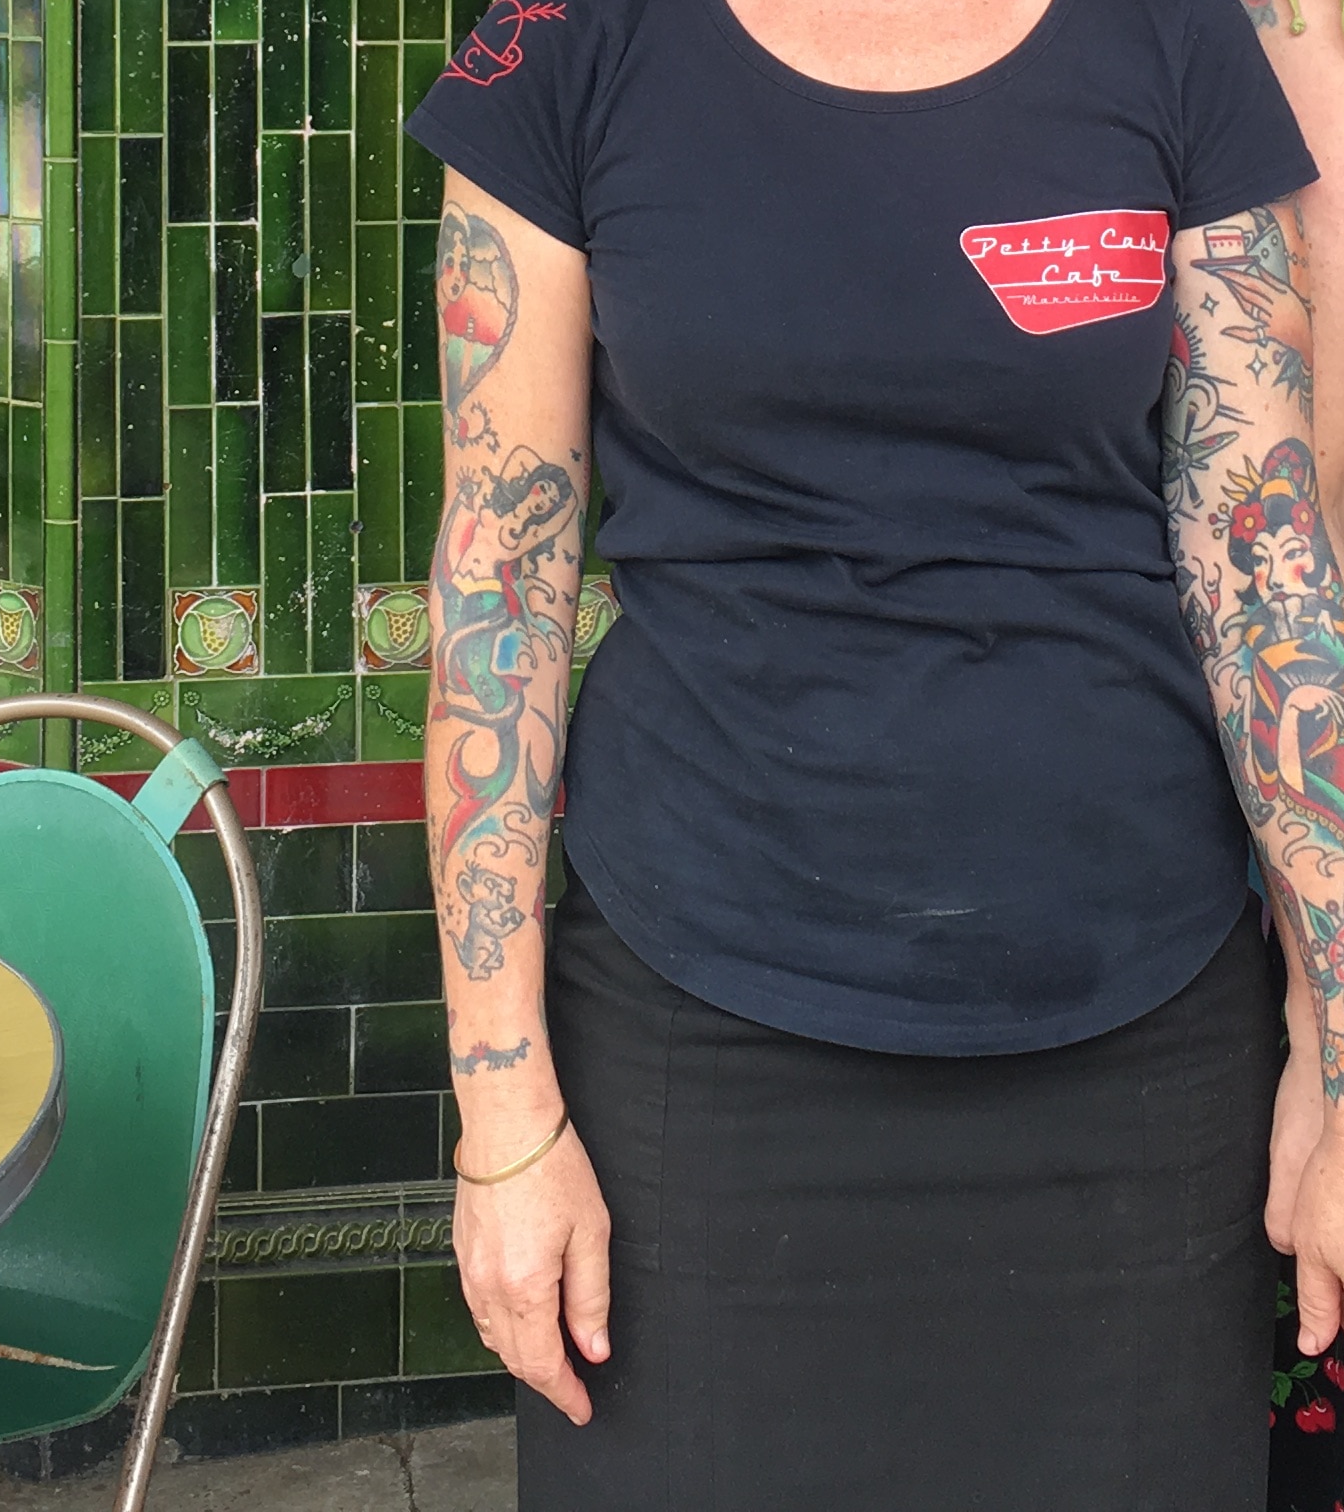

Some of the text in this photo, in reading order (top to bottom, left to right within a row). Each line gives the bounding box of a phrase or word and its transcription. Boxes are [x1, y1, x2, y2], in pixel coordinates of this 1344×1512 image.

[969, 228, 1163, 259] Petty Cash
[1042, 264, 1121, 288] Cafe
